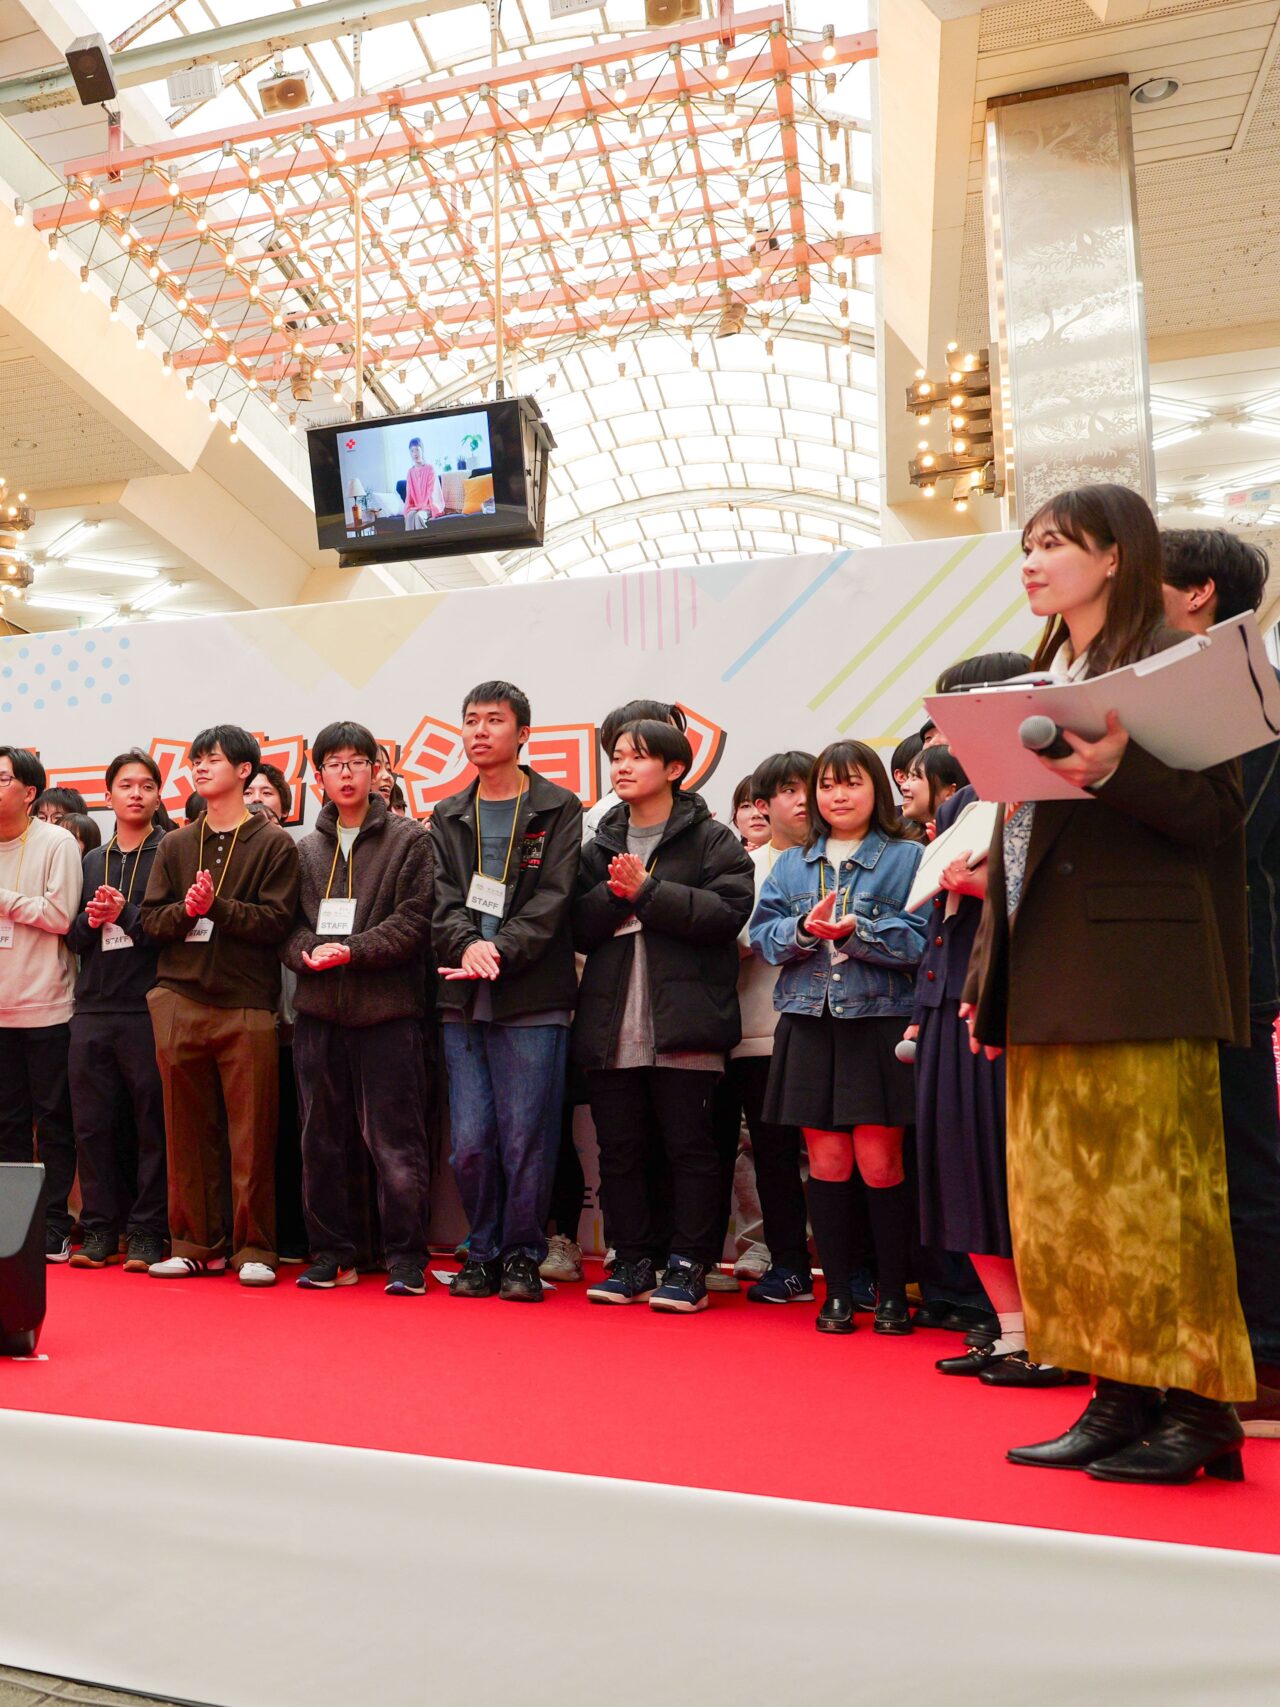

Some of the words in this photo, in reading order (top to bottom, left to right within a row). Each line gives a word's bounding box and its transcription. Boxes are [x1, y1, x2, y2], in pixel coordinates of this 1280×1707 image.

[471, 895, 500, 910] STAFF
[321, 921, 349, 929] STAFF
[105, 935, 129, 945] STAFF
